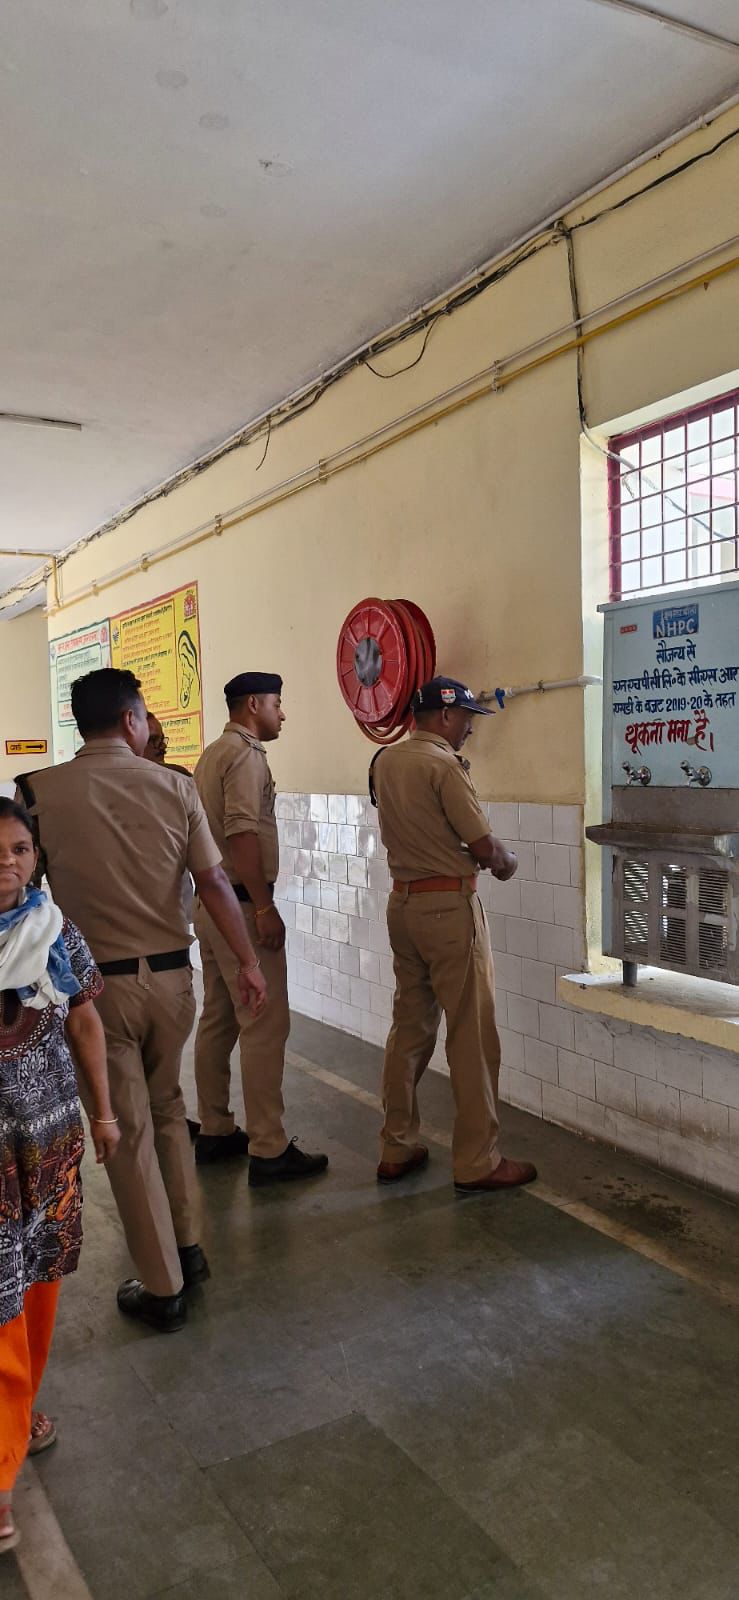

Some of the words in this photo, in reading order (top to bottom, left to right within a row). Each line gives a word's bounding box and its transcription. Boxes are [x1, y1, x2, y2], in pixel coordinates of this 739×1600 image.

[656, 618, 695, 638] NHPC
[686, 639, 697, 662] से
[715, 692, 736, 709] तहत
[667, 719, 692, 744] मना
